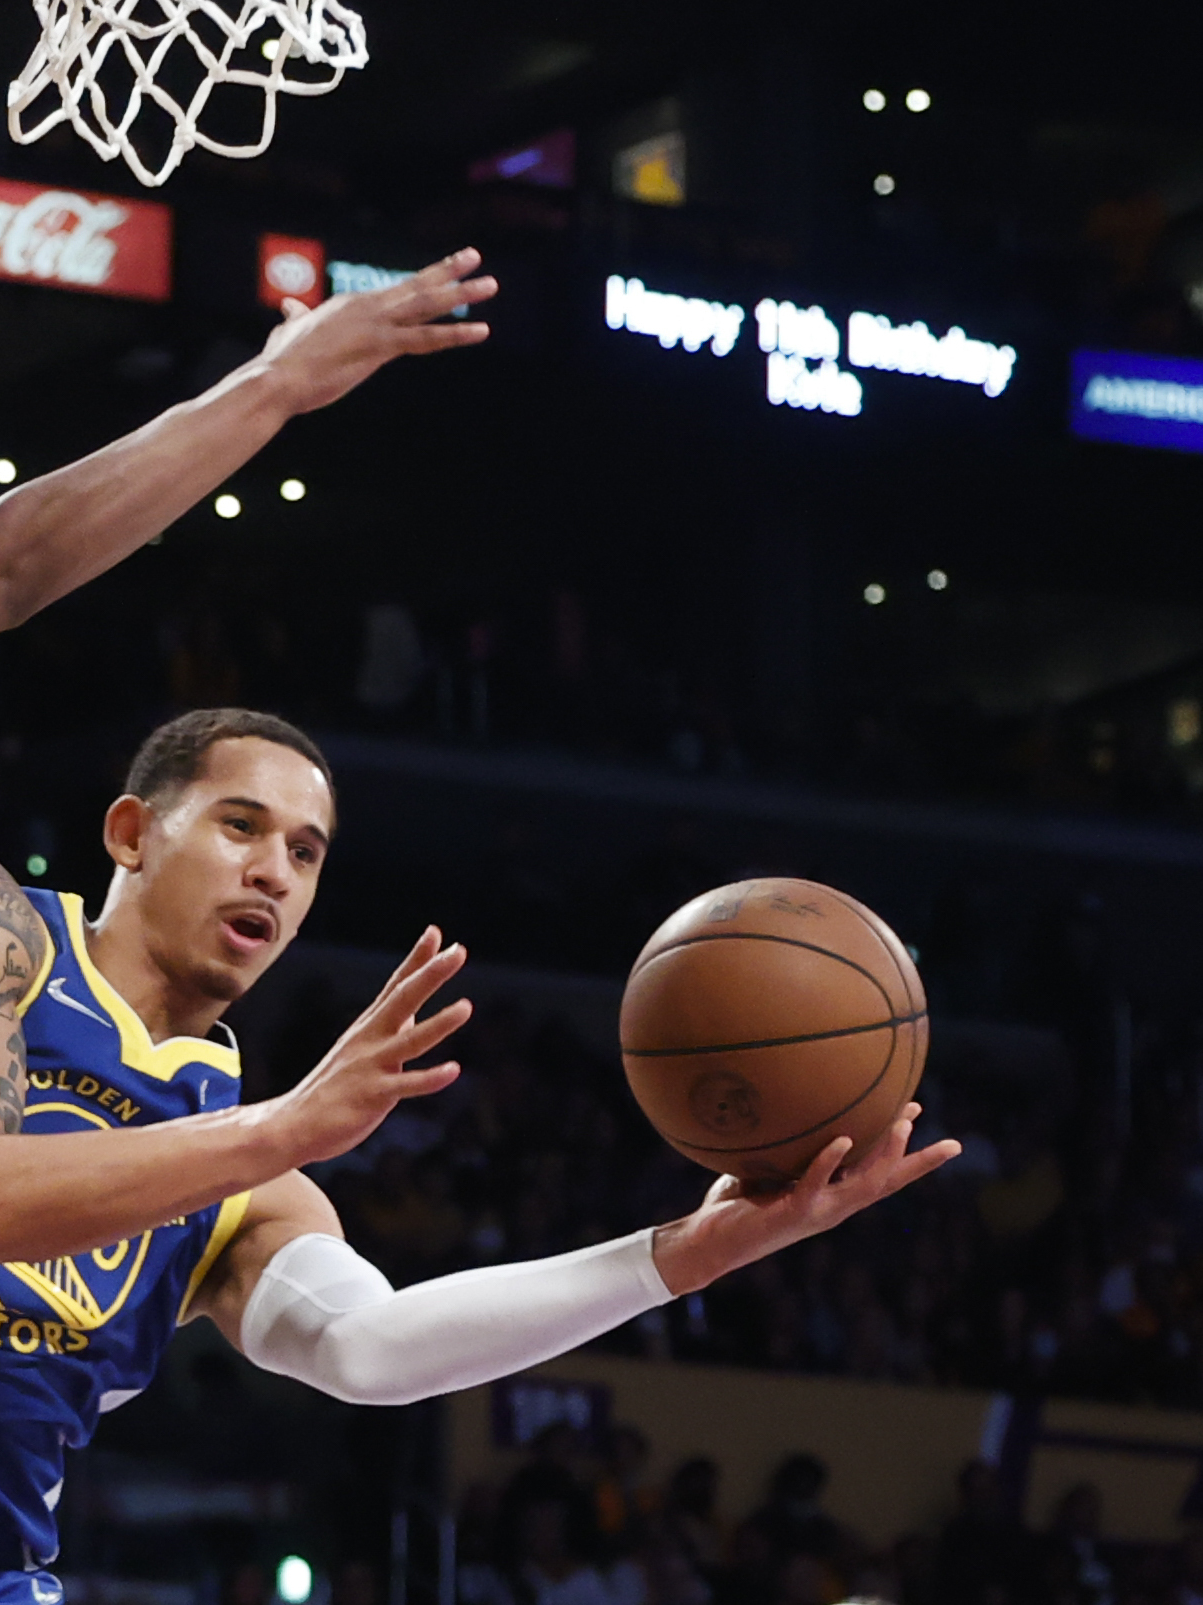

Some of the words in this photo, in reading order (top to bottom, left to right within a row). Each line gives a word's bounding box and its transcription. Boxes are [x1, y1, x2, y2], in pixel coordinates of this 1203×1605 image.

[606, 275, 744, 357] Happy
[849, 311, 1017, 398] Birthday
[22, 1069, 141, 1122] OLDEN
